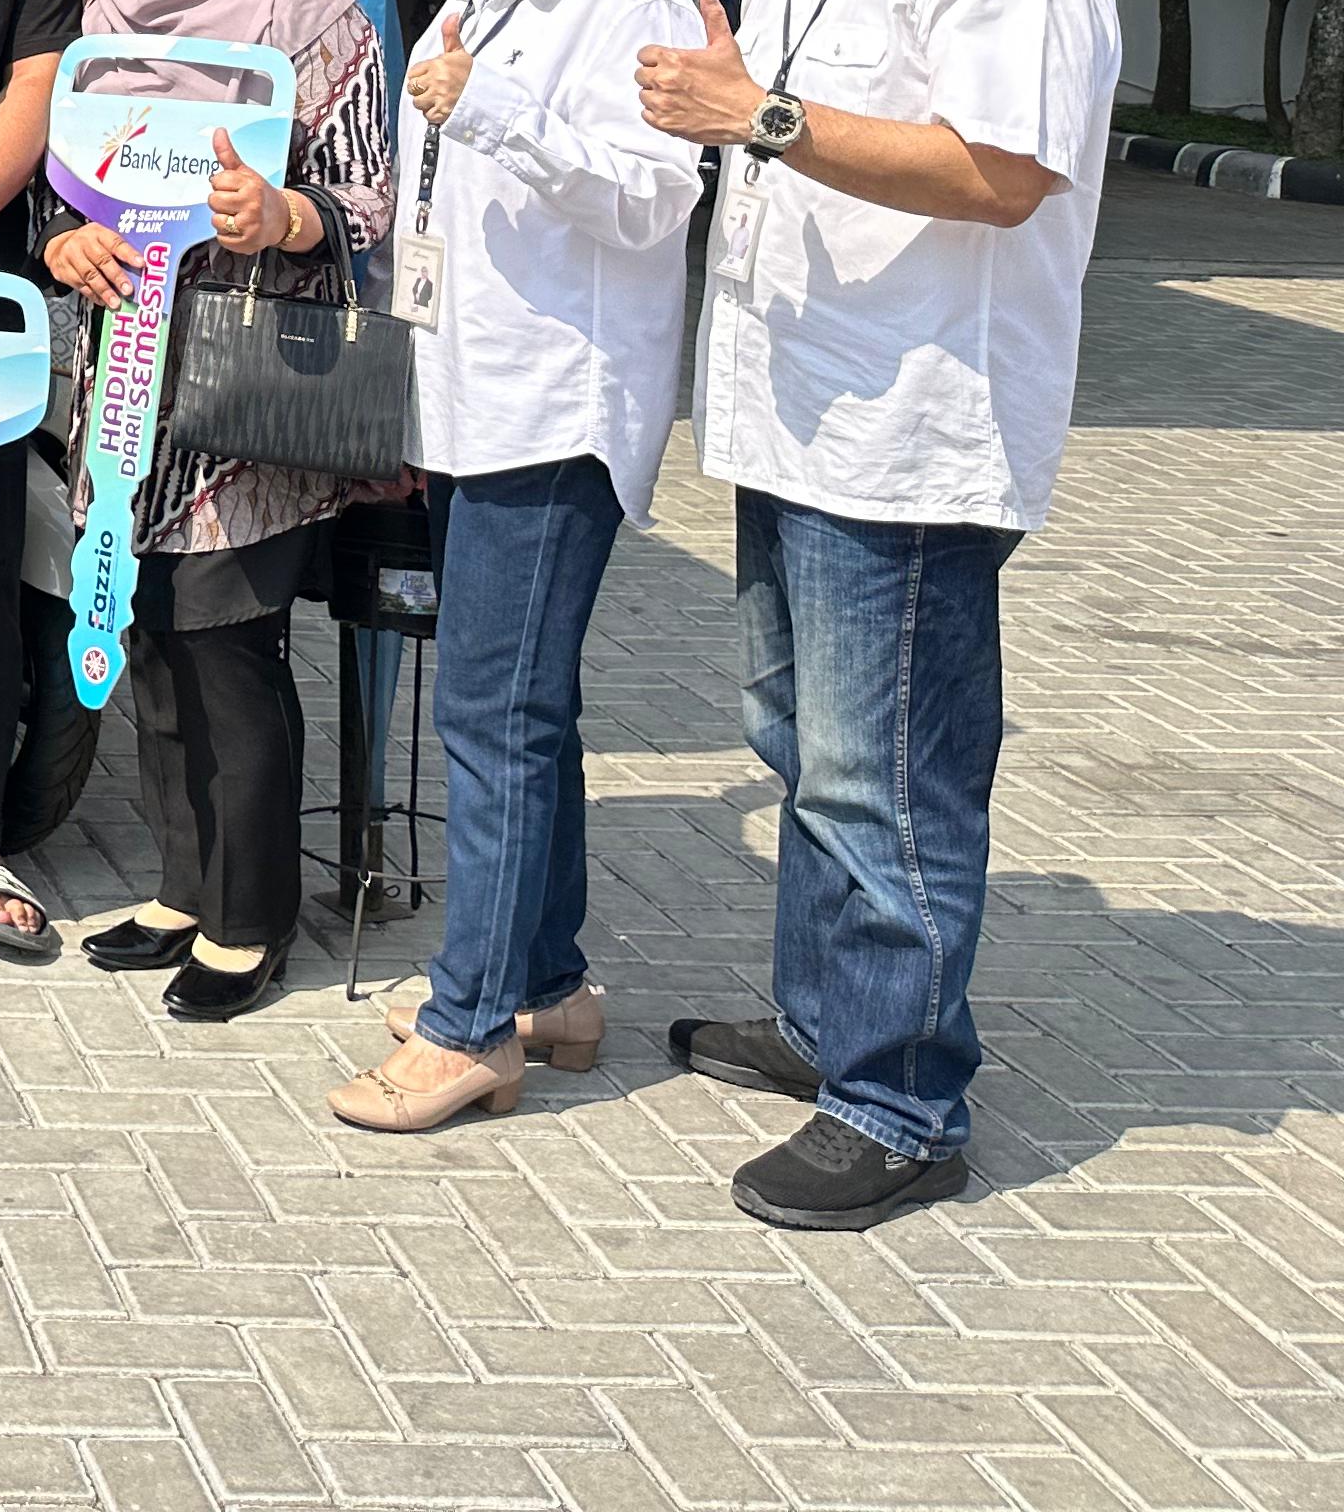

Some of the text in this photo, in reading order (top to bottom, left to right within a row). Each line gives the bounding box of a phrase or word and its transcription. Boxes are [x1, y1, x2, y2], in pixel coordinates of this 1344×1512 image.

[119, 144, 162, 171] Bank
[136, 222, 164, 233] BAIK
[100, 314, 134, 453] HADIAH
[121, 244, 169, 477] DARI SEMESTA
[88, 530, 114, 631] Fazzio
